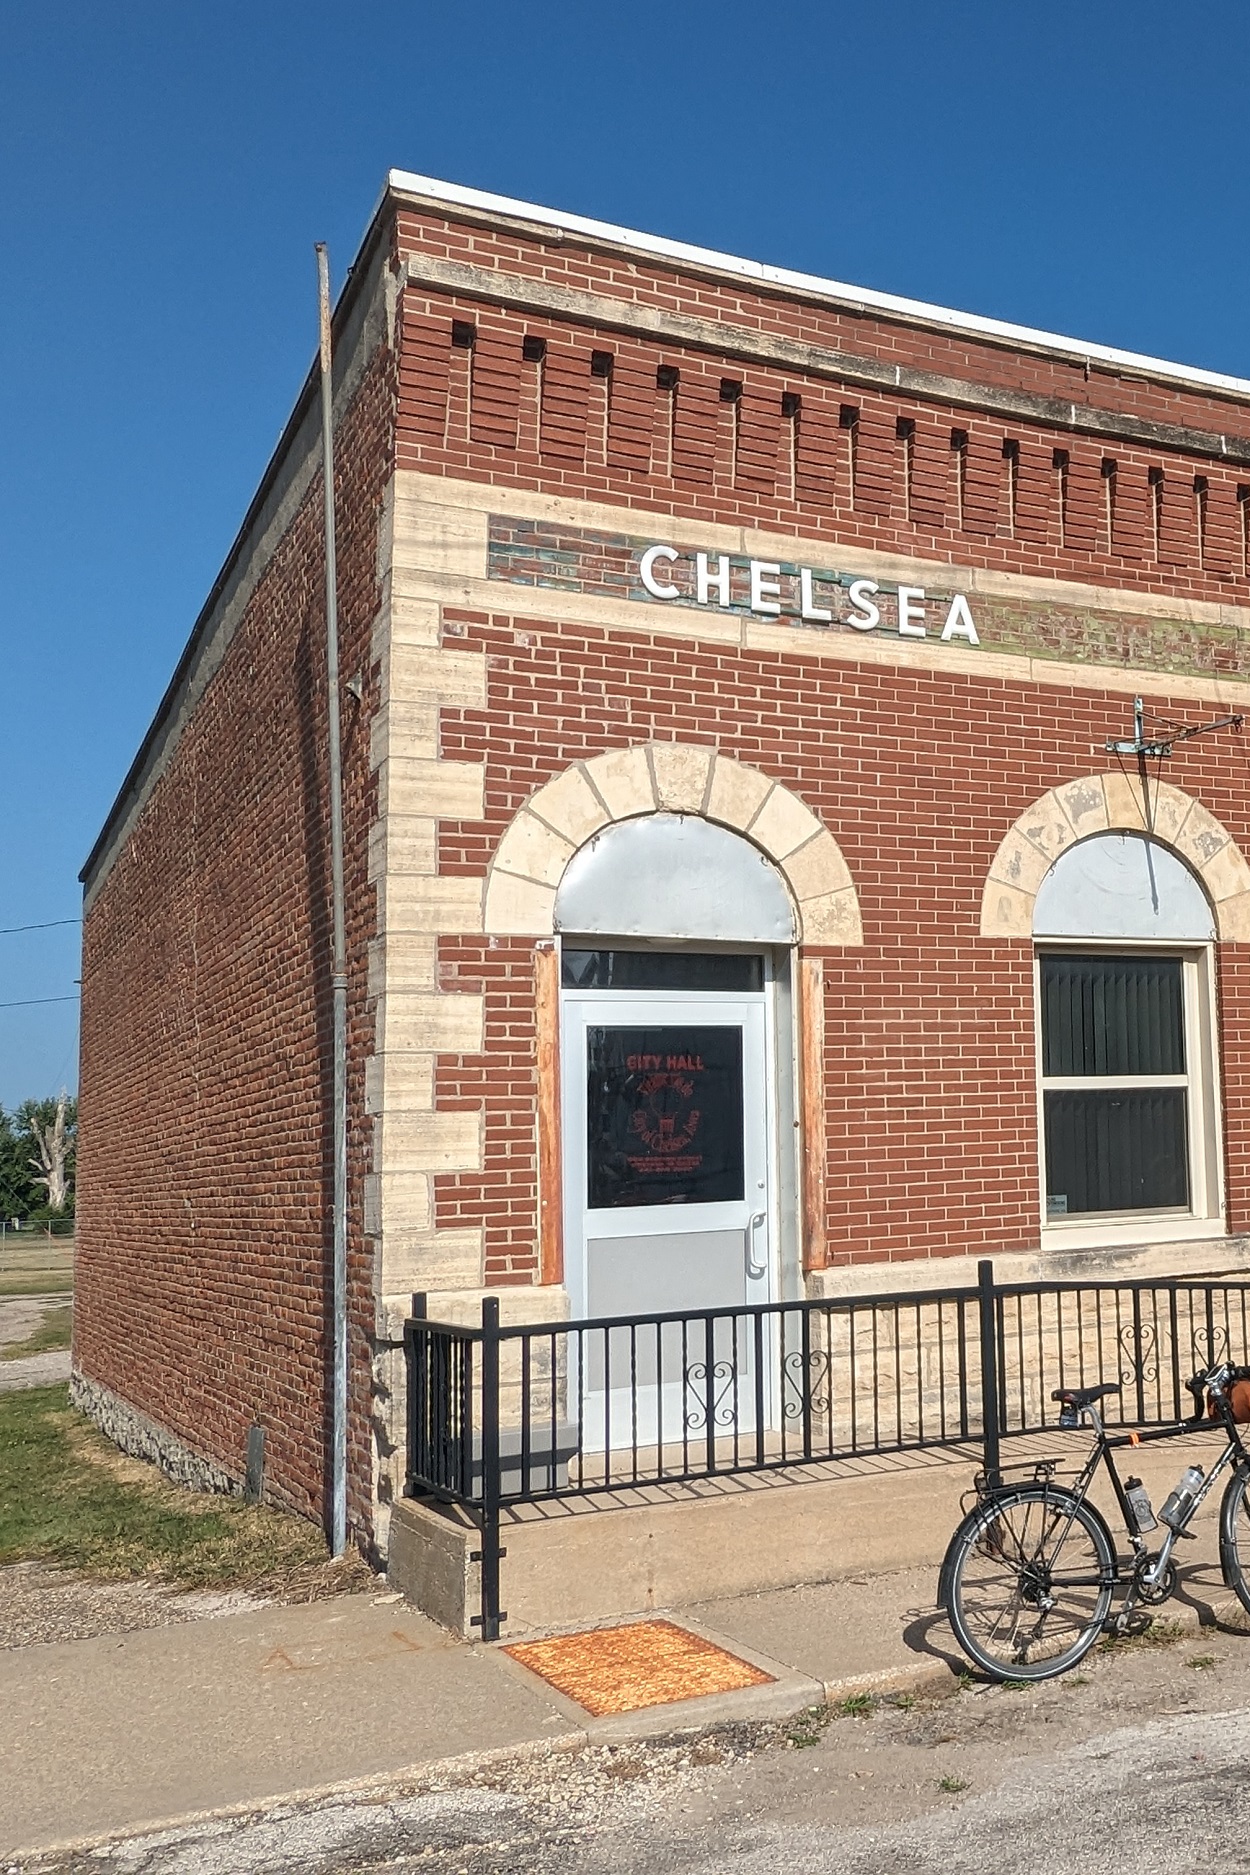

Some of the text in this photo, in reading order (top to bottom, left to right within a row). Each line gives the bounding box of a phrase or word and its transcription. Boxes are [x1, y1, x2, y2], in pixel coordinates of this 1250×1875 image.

[640, 545, 980, 645] CHELSEA
[627, 1055, 704, 1071] CITY HALL
